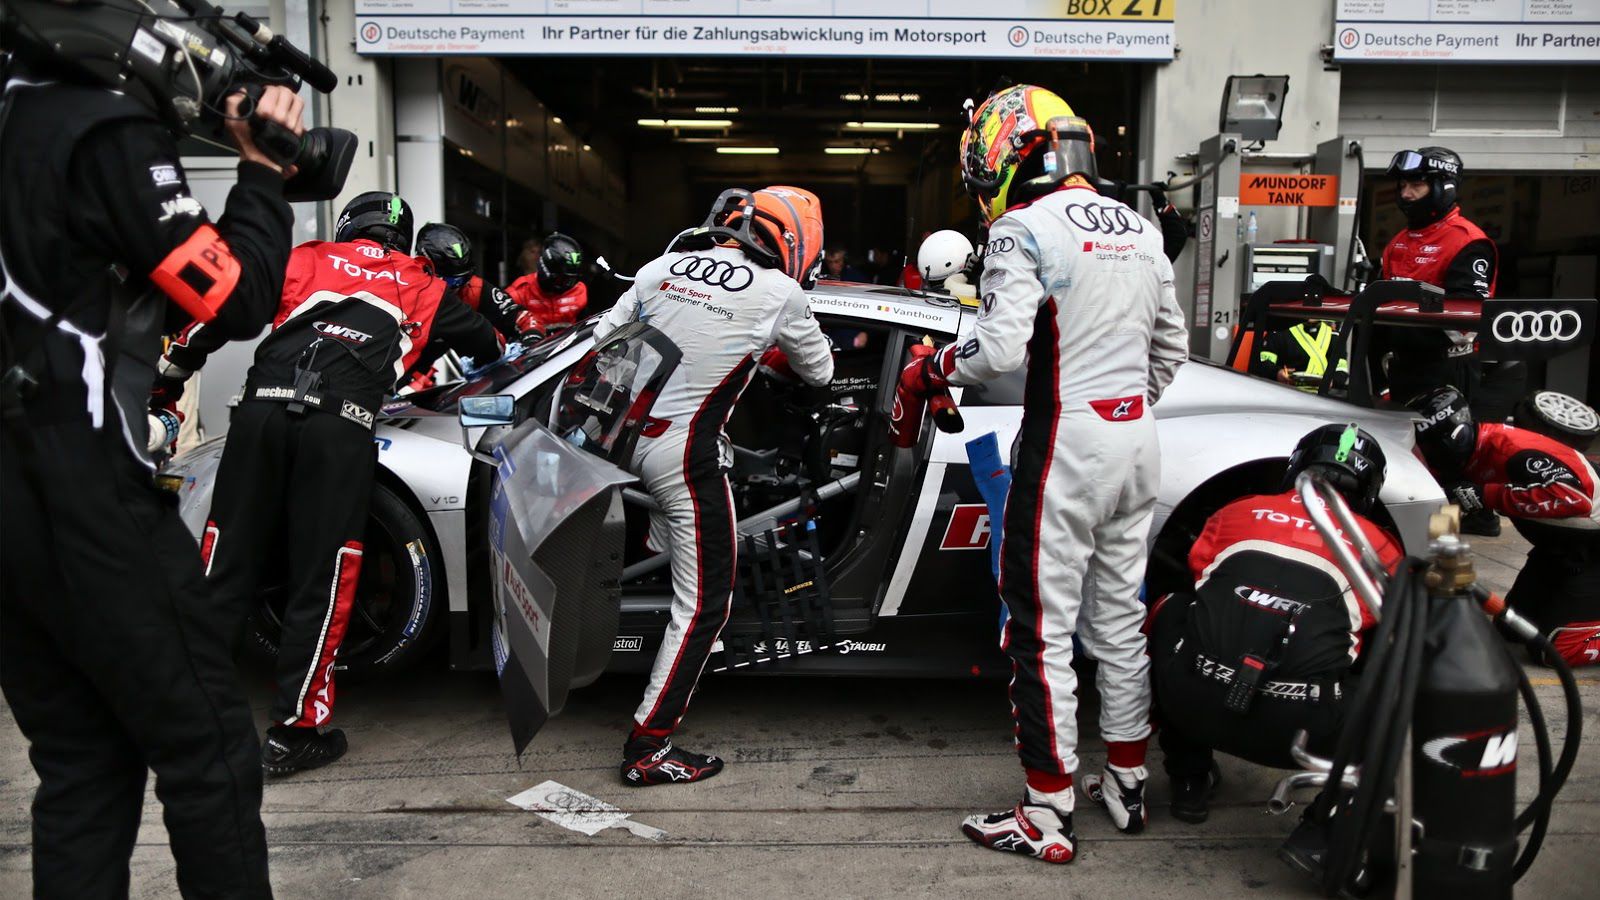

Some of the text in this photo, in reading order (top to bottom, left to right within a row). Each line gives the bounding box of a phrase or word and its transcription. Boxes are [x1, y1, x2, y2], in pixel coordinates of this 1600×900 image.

[1067, 0, 1112, 16] BOX
[387, 26, 525, 43] Deutsche Payment
[542, 26, 987, 45] Ihr Partner für die Zahlungsabwicklung im Motorsport
[1033, 31, 1170, 48] Deutsche Payment
[1364, 33, 1499, 50] Deutsche Payment
[1516, 33, 1538, 48] Ihr
[1428, 157, 1459, 174] uvex
[1248, 177, 1327, 189] MUNDORF
[1267, 192, 1305, 204] TANK
[327, 254, 408, 285] TOTAL
[669, 284, 713, 301] Audi Sport
[665, 292, 734, 319] customer racing
[810, 297, 944, 322] Sandström Vanthoor
[1214, 311, 1230, 323] 21
[323, 323, 373, 342] WRT
[1416, 405, 1455, 432] uvex
